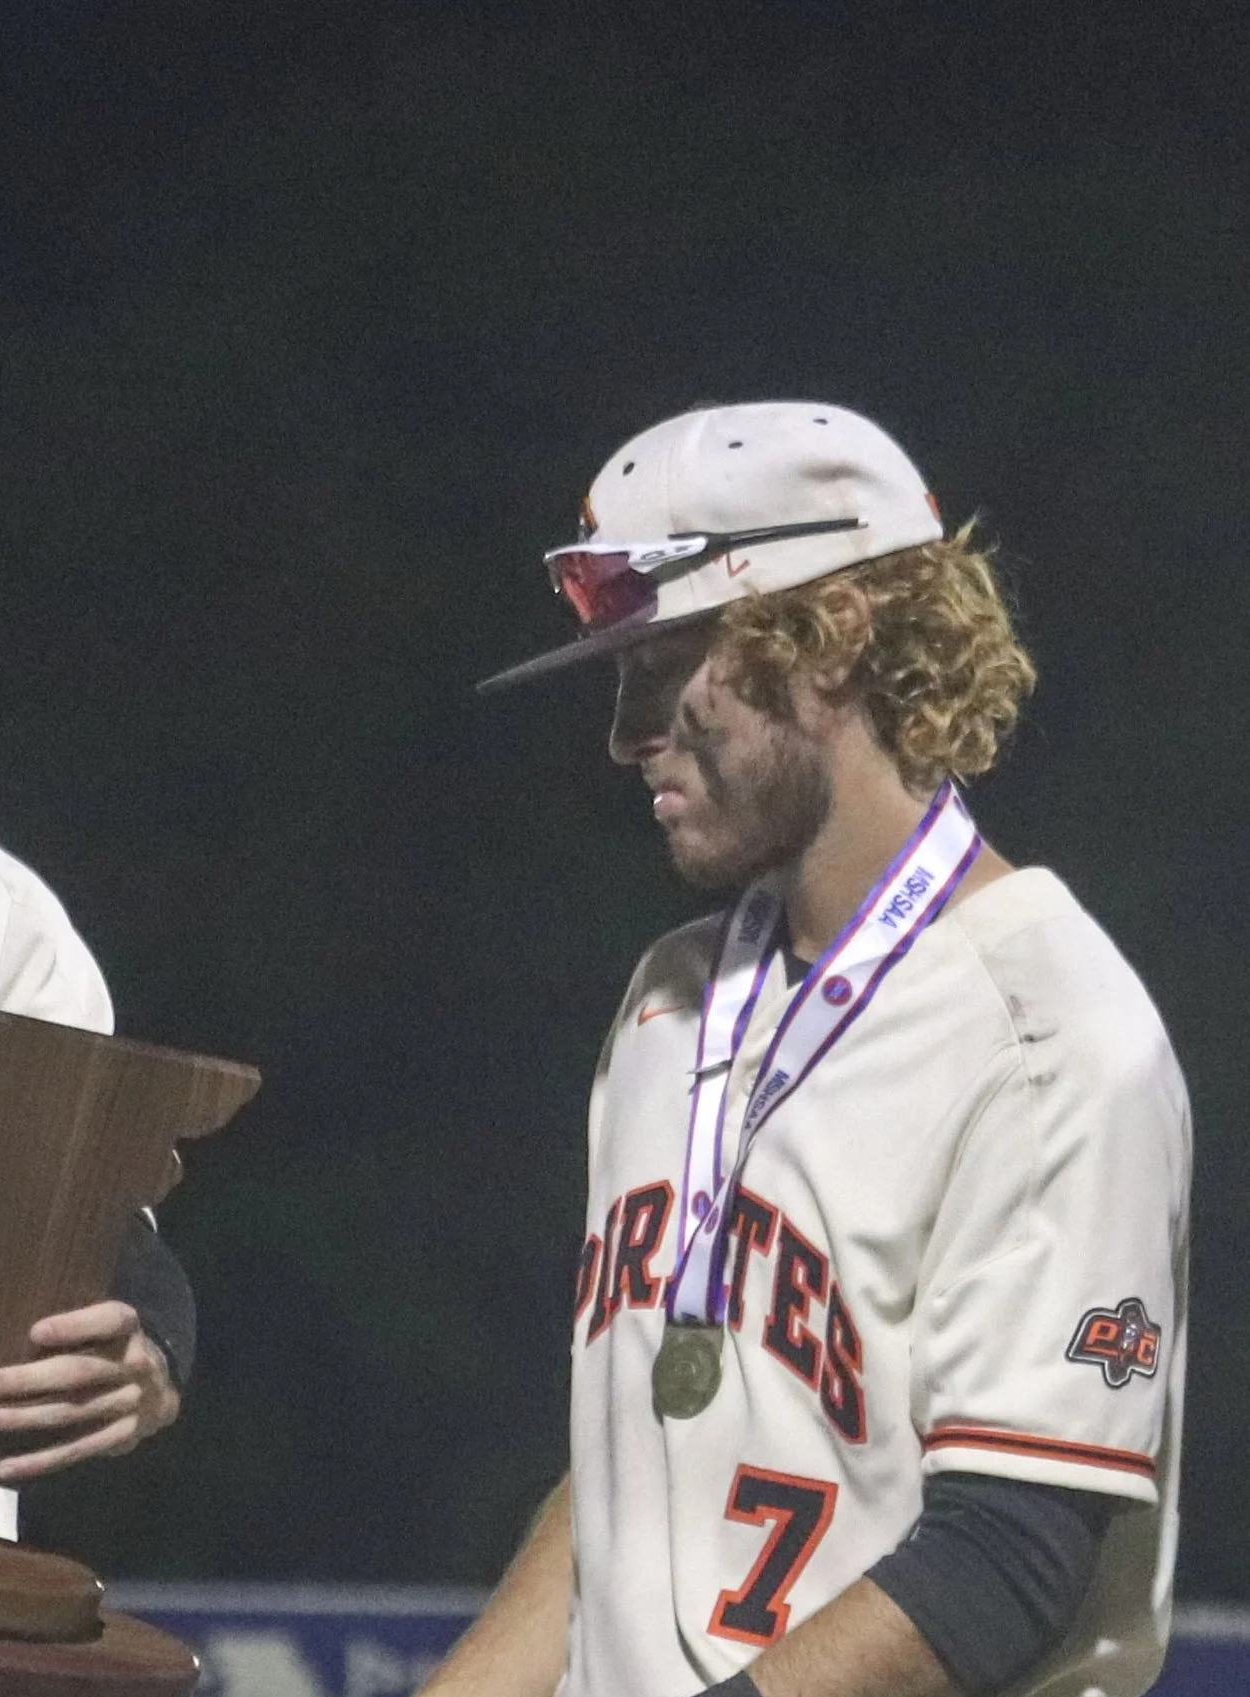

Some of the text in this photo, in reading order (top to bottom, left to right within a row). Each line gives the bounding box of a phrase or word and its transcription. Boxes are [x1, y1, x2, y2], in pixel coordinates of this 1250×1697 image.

[878, 865, 936, 929] MSHSAA
[573, 1179, 867, 1445] PIRTES
[706, 1462, 839, 1648] 7
